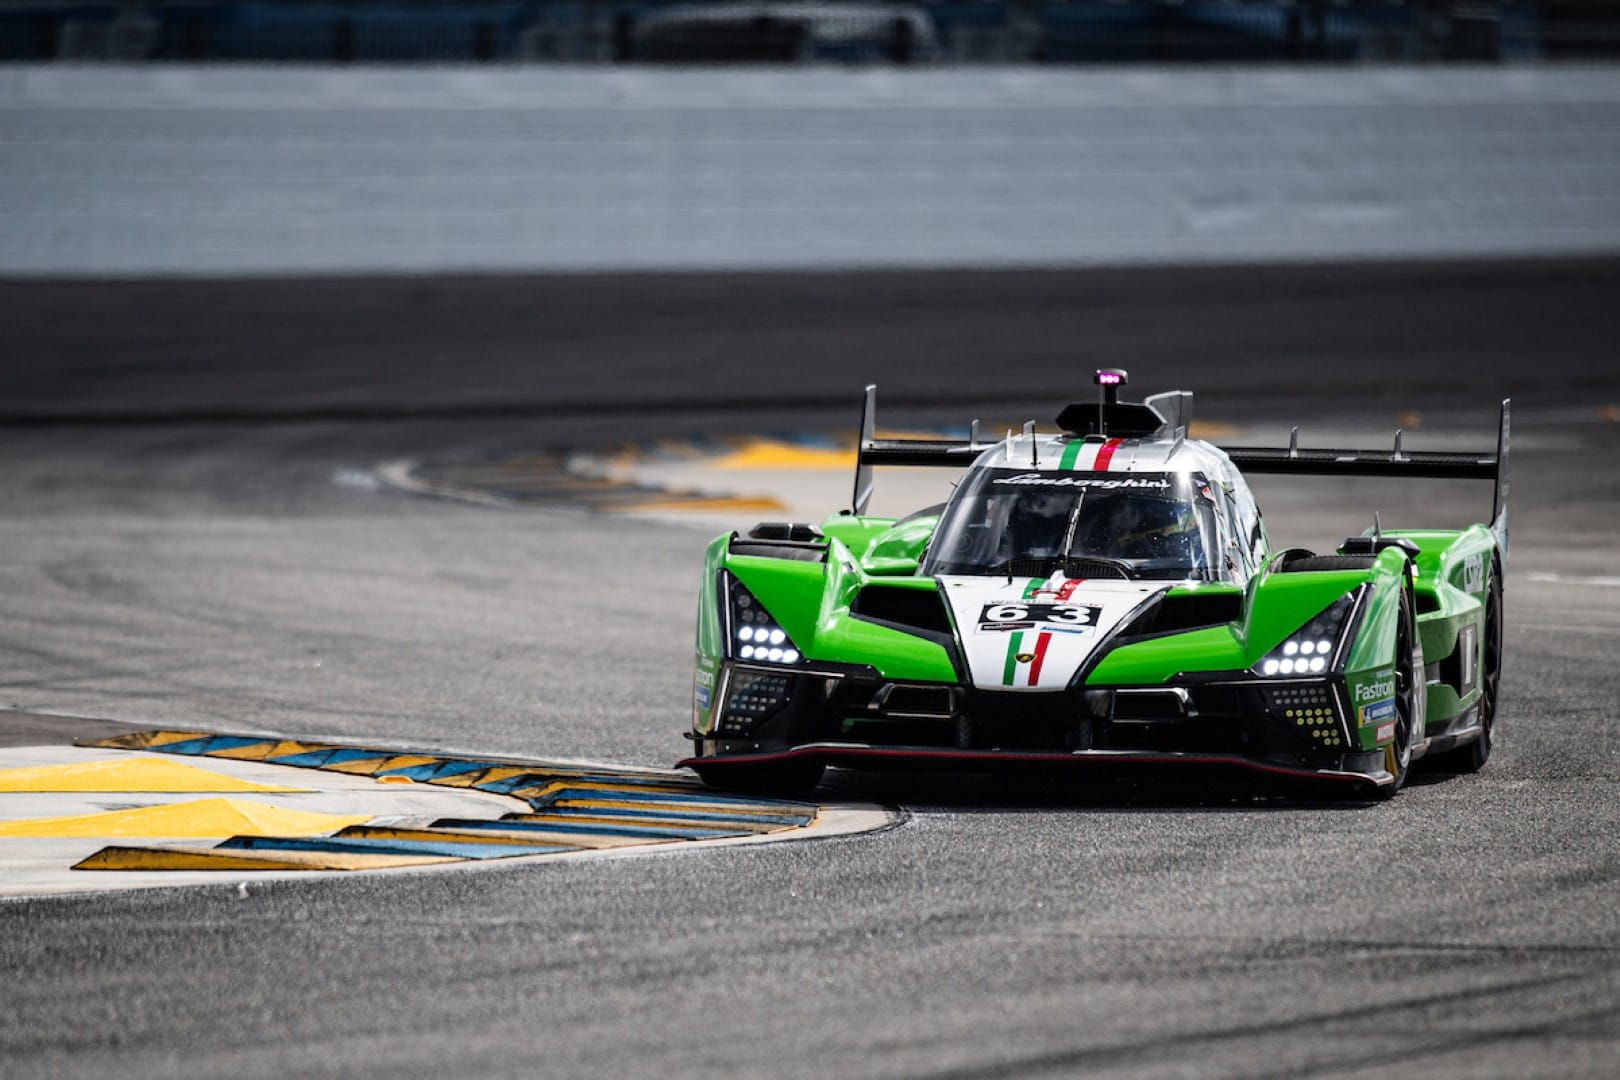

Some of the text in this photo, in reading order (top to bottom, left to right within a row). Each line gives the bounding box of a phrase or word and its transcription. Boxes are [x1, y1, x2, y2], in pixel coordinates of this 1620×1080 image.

[993, 473, 1171, 489] Lamborghini
[986, 605, 1090, 624] 63
[1356, 681, 1394, 702] Fastron
